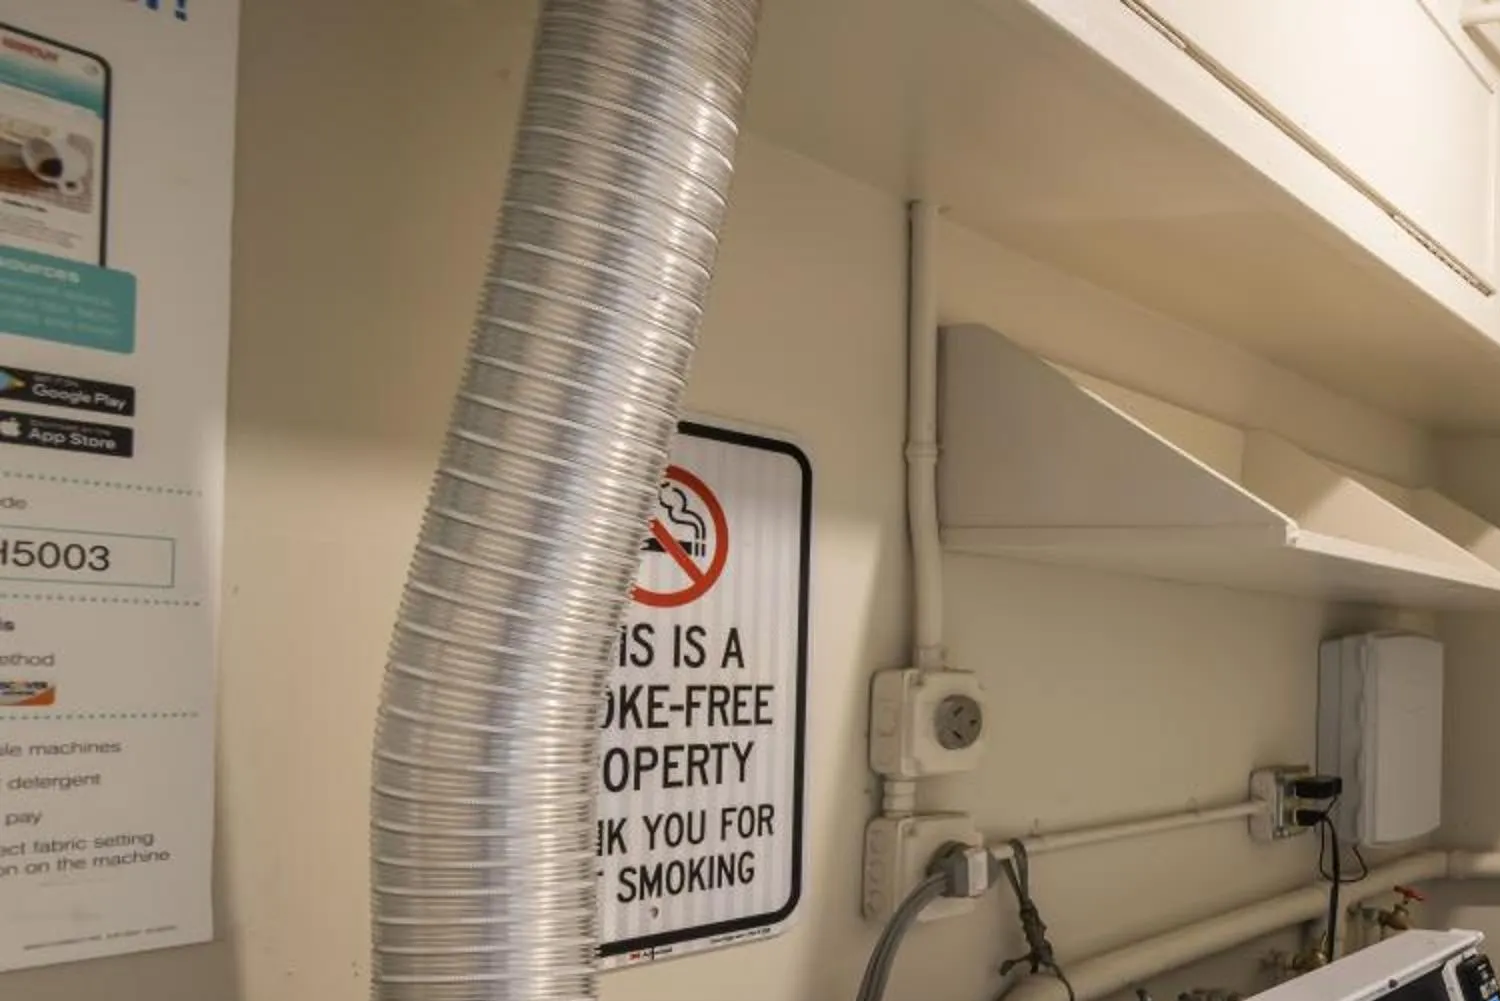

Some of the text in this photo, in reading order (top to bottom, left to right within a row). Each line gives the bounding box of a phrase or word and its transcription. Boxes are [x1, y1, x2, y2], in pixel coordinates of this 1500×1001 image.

[32, 382, 127, 412] Google Play
[29, 427, 66, 445] App
[69, 432, 118, 451] Store
[0, 495, 28, 510] de
[618, 621, 745, 669] IS IS A
[0, 652, 56, 668] ethod
[600, 684, 775, 730] KE-FREE
[29, 740, 123, 757] machines
[602, 740, 755, 793] OPERTY
[6, 772, 102, 791] detergent
[4, 811, 44, 827] pay
[641, 809, 707, 851] YOU
[720, 803, 776, 842] FOR
[33, 837, 89, 854] fabric
[93, 831, 156, 849] setting
[24, 863, 50, 876] on
[56, 857, 88, 872] the
[92, 849, 172, 868] machine
[616, 851, 756, 904] SMOKING
